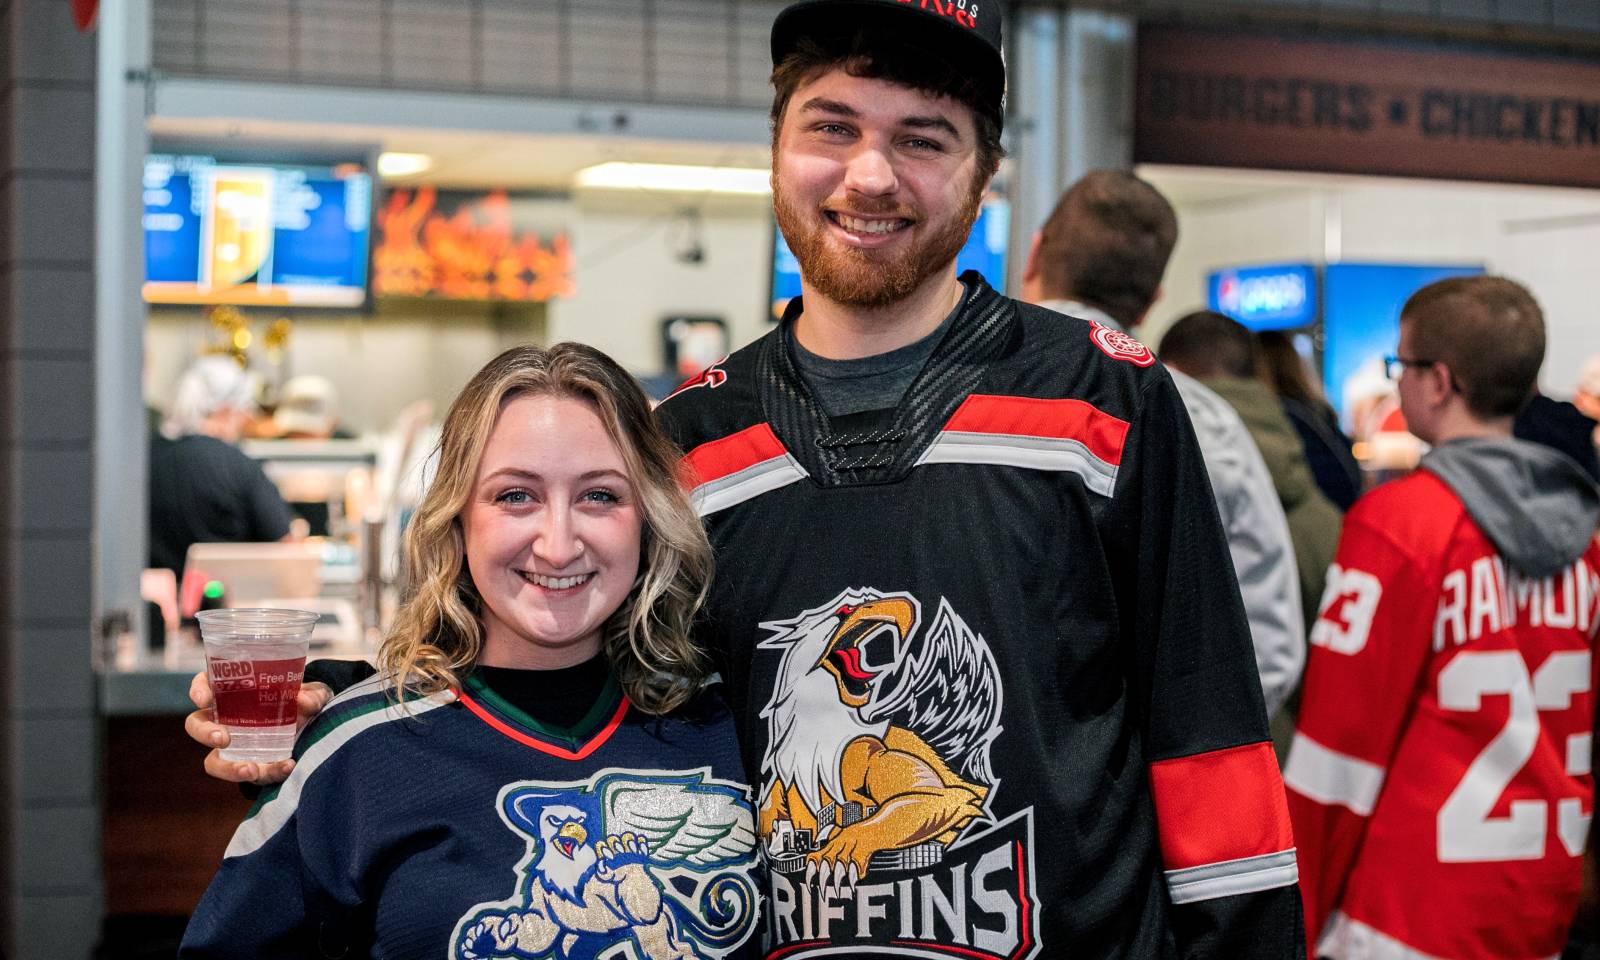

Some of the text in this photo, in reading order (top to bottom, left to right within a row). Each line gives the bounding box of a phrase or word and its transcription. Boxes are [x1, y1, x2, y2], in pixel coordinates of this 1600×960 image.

[1150, 73, 1600, 147] BURGERS CHICKEN
[1309, 562, 1383, 656] 23
[211, 661, 252, 678] WGRD
[259, 673, 284, 684] Free
[259, 690, 277, 702] Hot
[1437, 649, 1592, 863] 23
[771, 840, 1019, 957] RIFFINS
